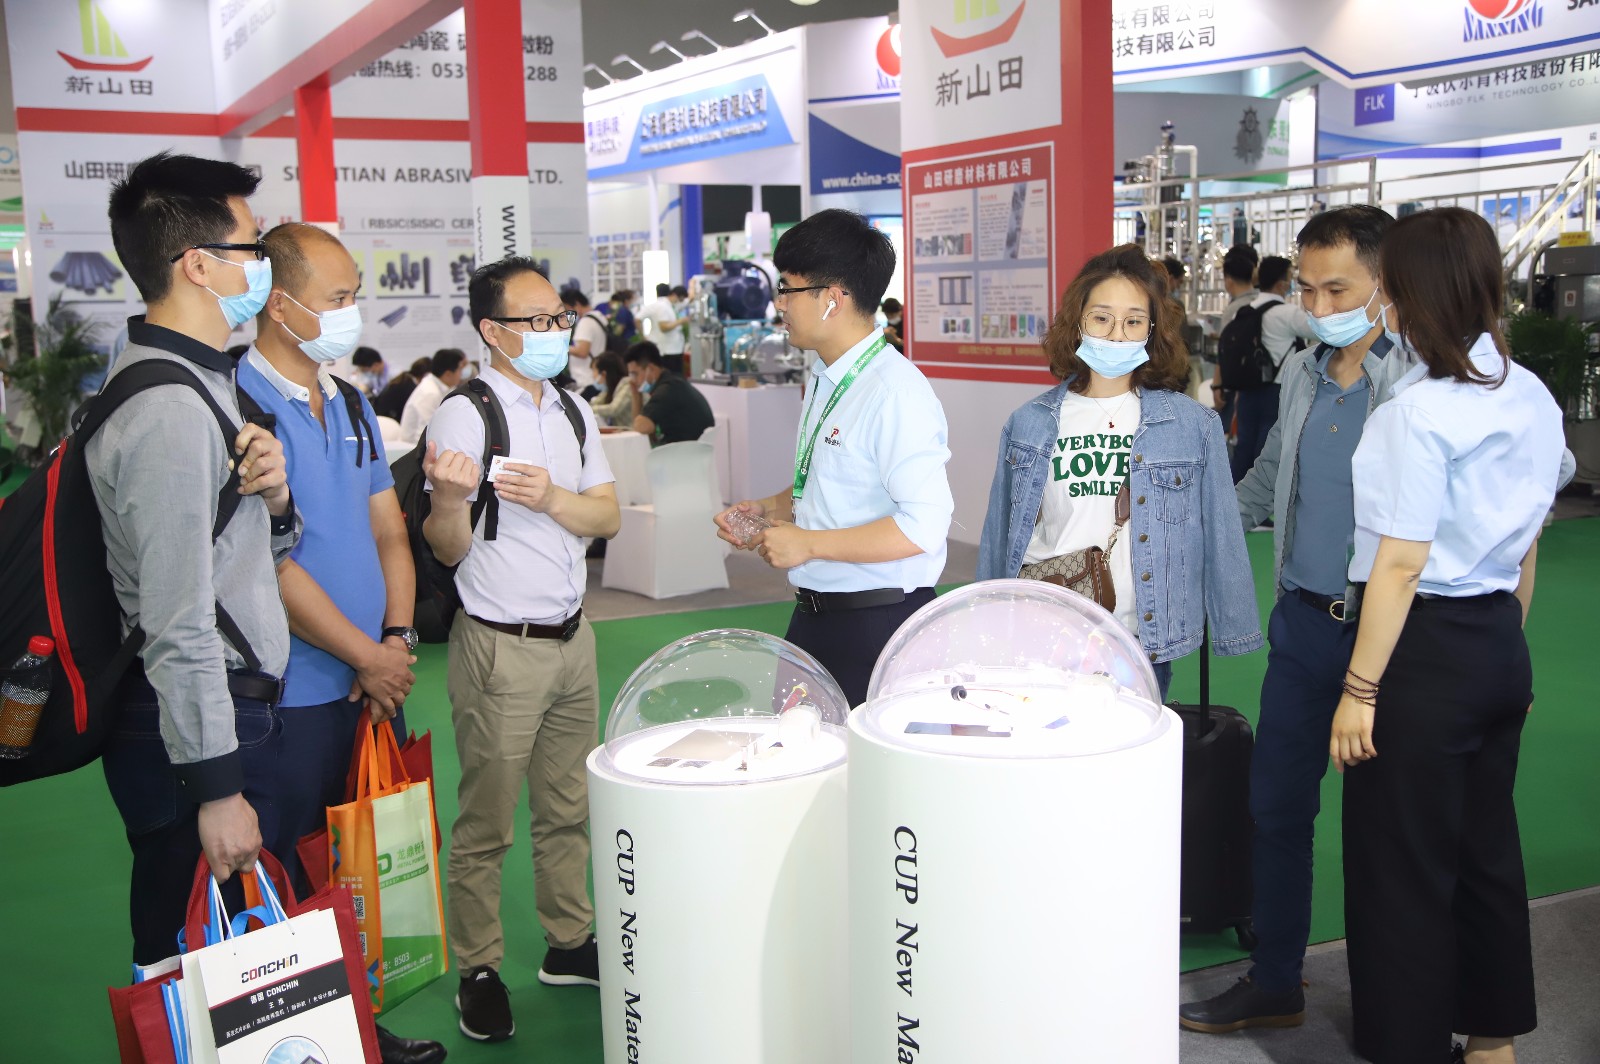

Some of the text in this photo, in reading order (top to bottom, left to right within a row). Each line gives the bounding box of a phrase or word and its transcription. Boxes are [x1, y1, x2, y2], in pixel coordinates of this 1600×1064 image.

[1567, 0, 1600, 10] SA
[432, 63, 468, 79] 053
[935, 56, 1023, 107] 新山田
[65, 76, 153, 96] 新山田
[1426, 96, 1463, 110] NINGBO
[1467, 93, 1485, 103] FLK
[1492, 81, 1564, 100] TECHNOLOGY
[1364, 93, 1385, 111] FLK
[923, 157, 1032, 189] 山田研磨材料有限公司
[1069, 480, 1121, 498] SMILE
[616, 828, 635, 896] CUP
[894, 825, 919, 905] CUP
[619, 907, 638, 975] New
[896, 918, 919, 997] New
[266, 979, 300, 998] CONCHIN
